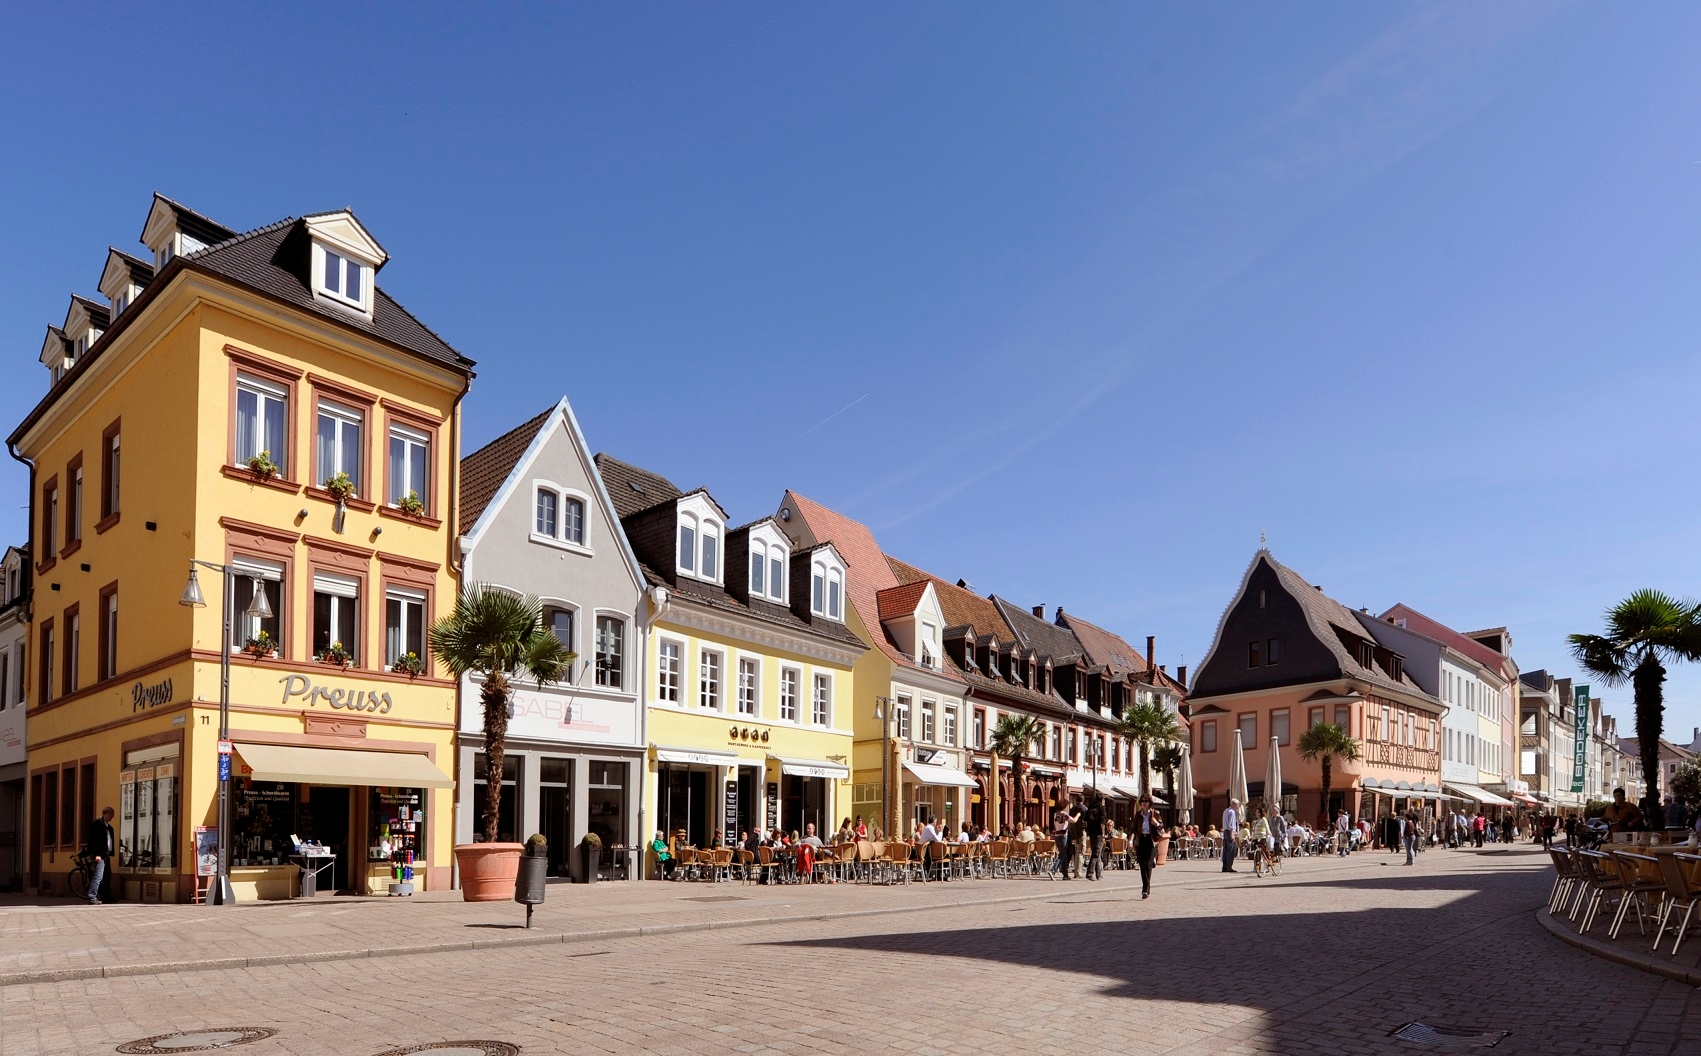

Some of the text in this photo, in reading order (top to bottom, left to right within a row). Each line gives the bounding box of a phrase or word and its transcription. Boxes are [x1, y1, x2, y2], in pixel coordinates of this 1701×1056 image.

[131, 678, 173, 713] Preuss
[279, 674, 392, 714] Preuss
[511, 695, 594, 724] SABEL
[200, 715, 209, 725] 11
